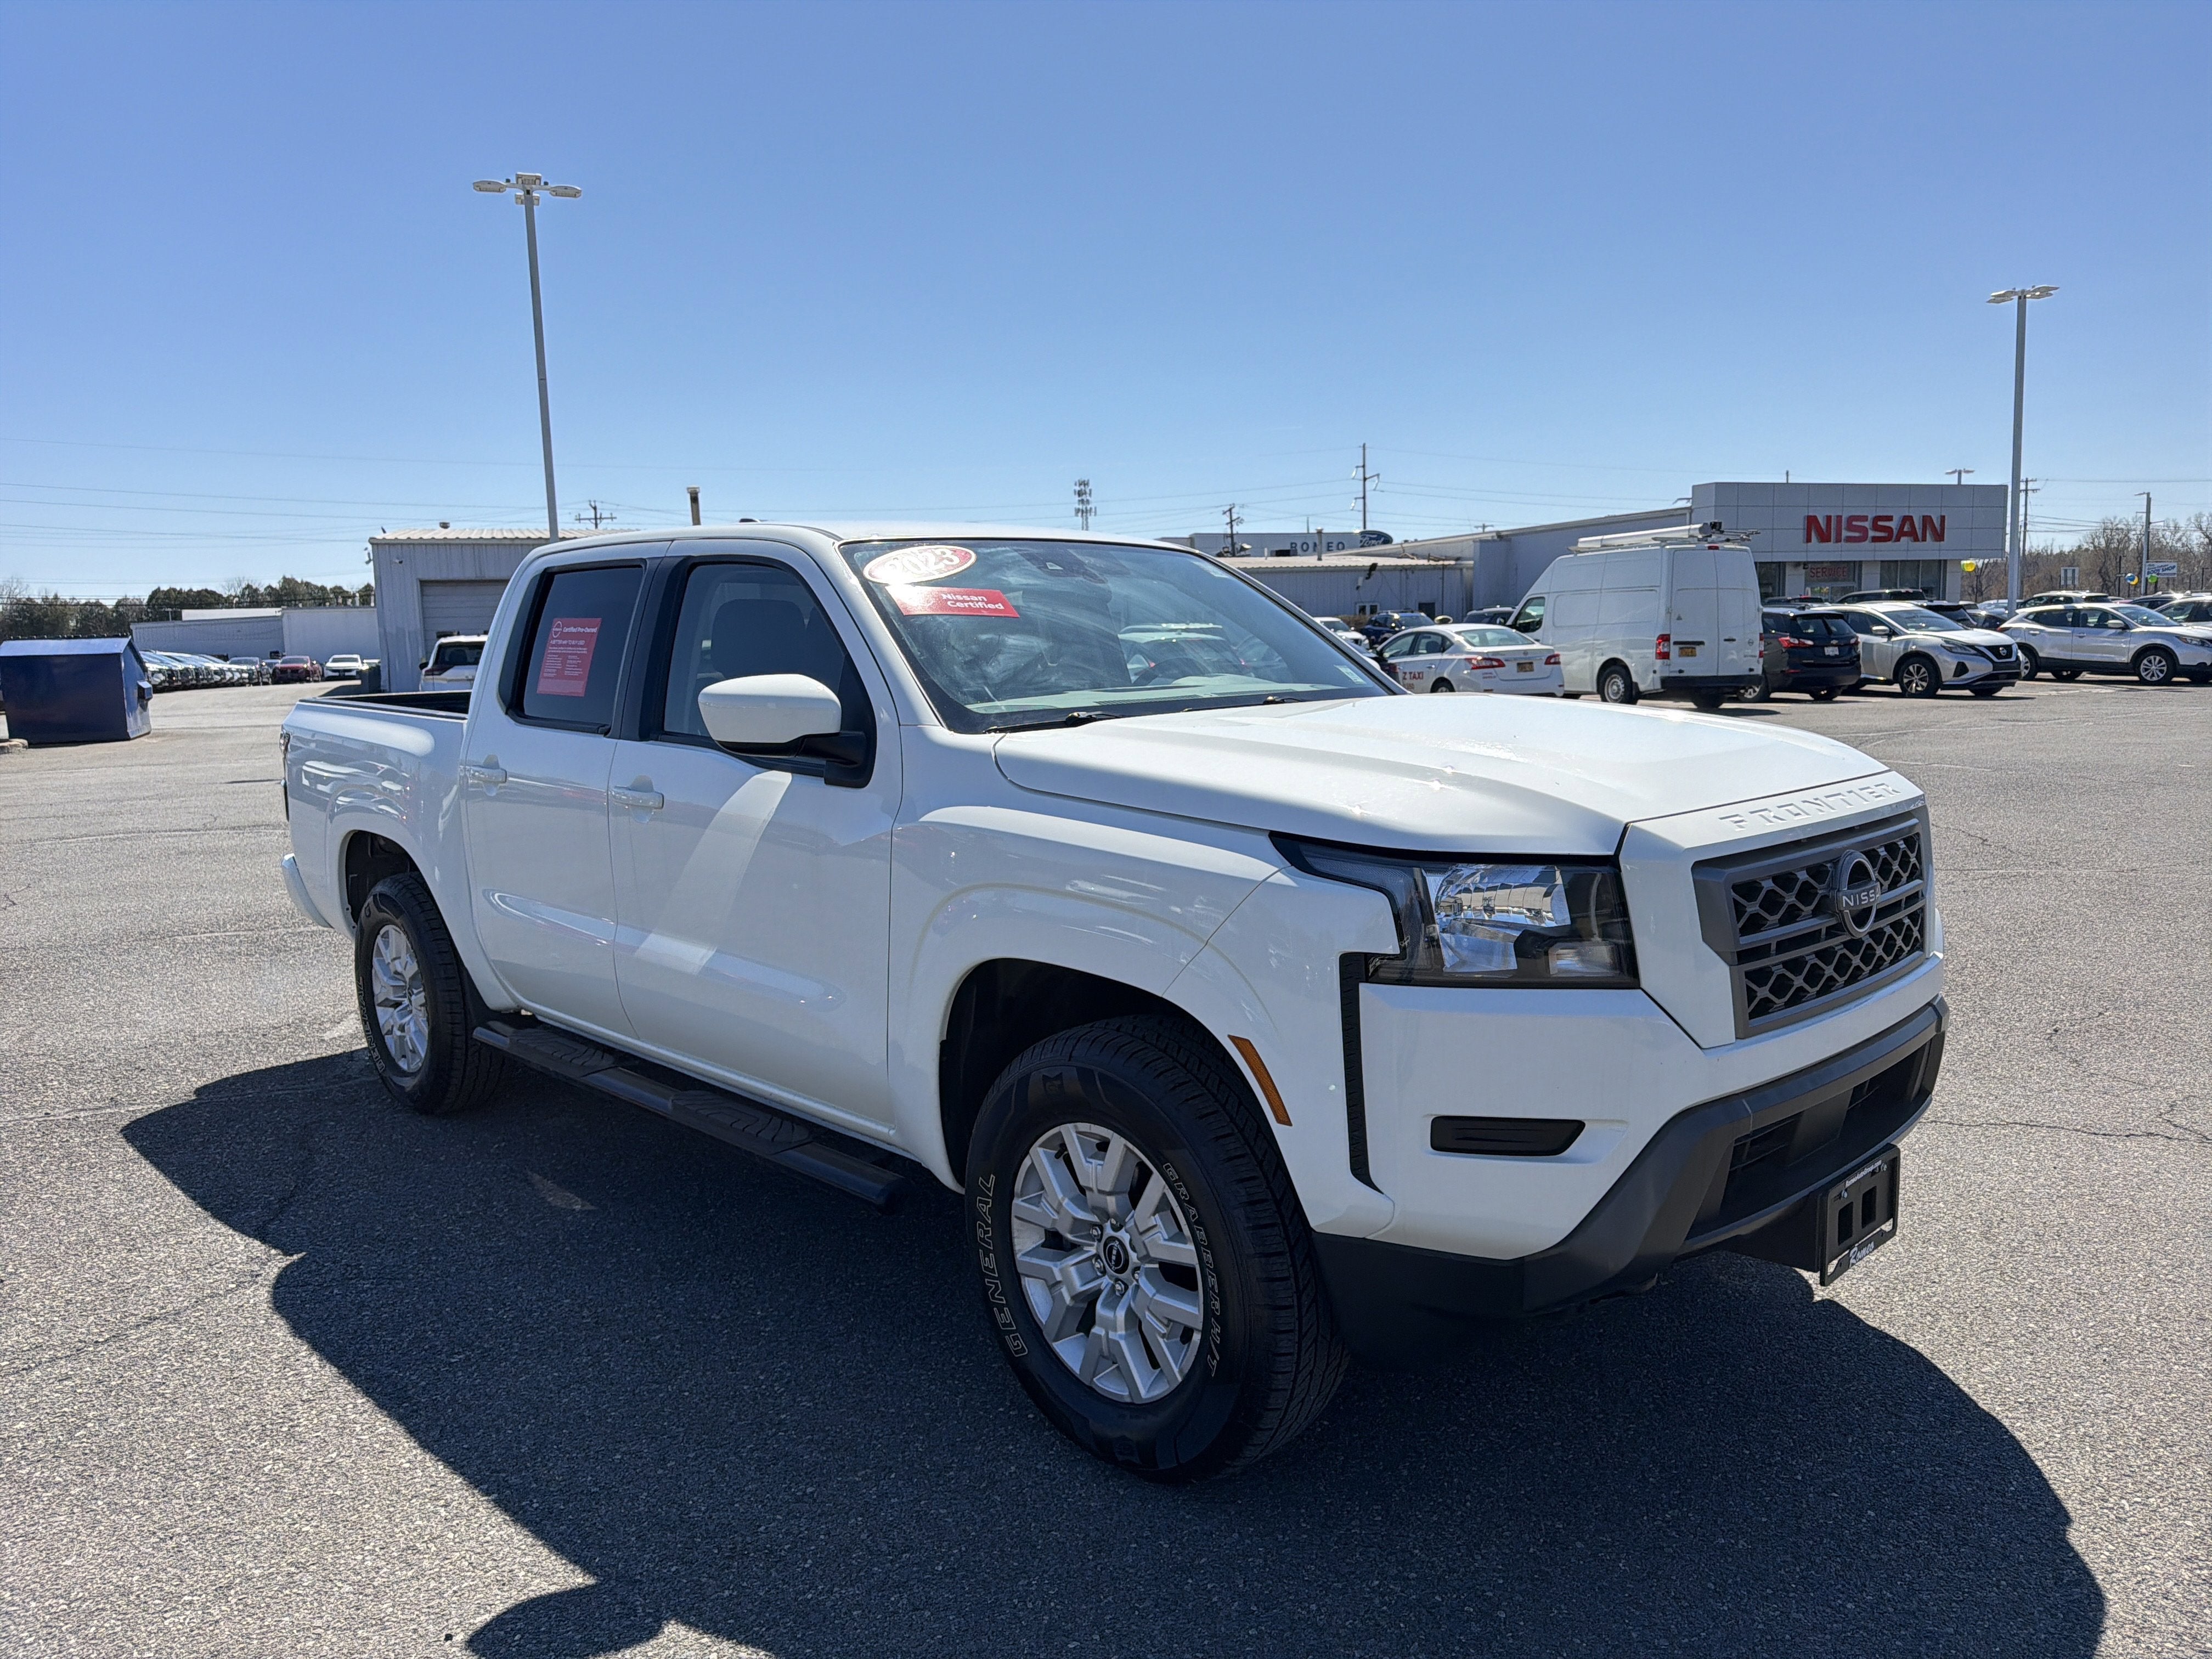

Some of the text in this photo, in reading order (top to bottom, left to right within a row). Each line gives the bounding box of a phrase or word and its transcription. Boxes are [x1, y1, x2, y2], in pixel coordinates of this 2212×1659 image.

[1805, 515, 1946, 543] NISSAN
[1361, 534, 1384, 546] Ford
[1810, 566, 1848, 578] SERVICE
[941, 593, 987, 602] Nissan
[947, 601, 1005, 610] Certified
[1409, 671, 1424, 680] TAXI
[1718, 782, 1901, 832] FRONTIER
[1163, 1162, 1221, 1316] GRABBER
[1849, 1241, 1874, 1268] Romeo
[977, 1173, 1028, 1358] GENERAL
